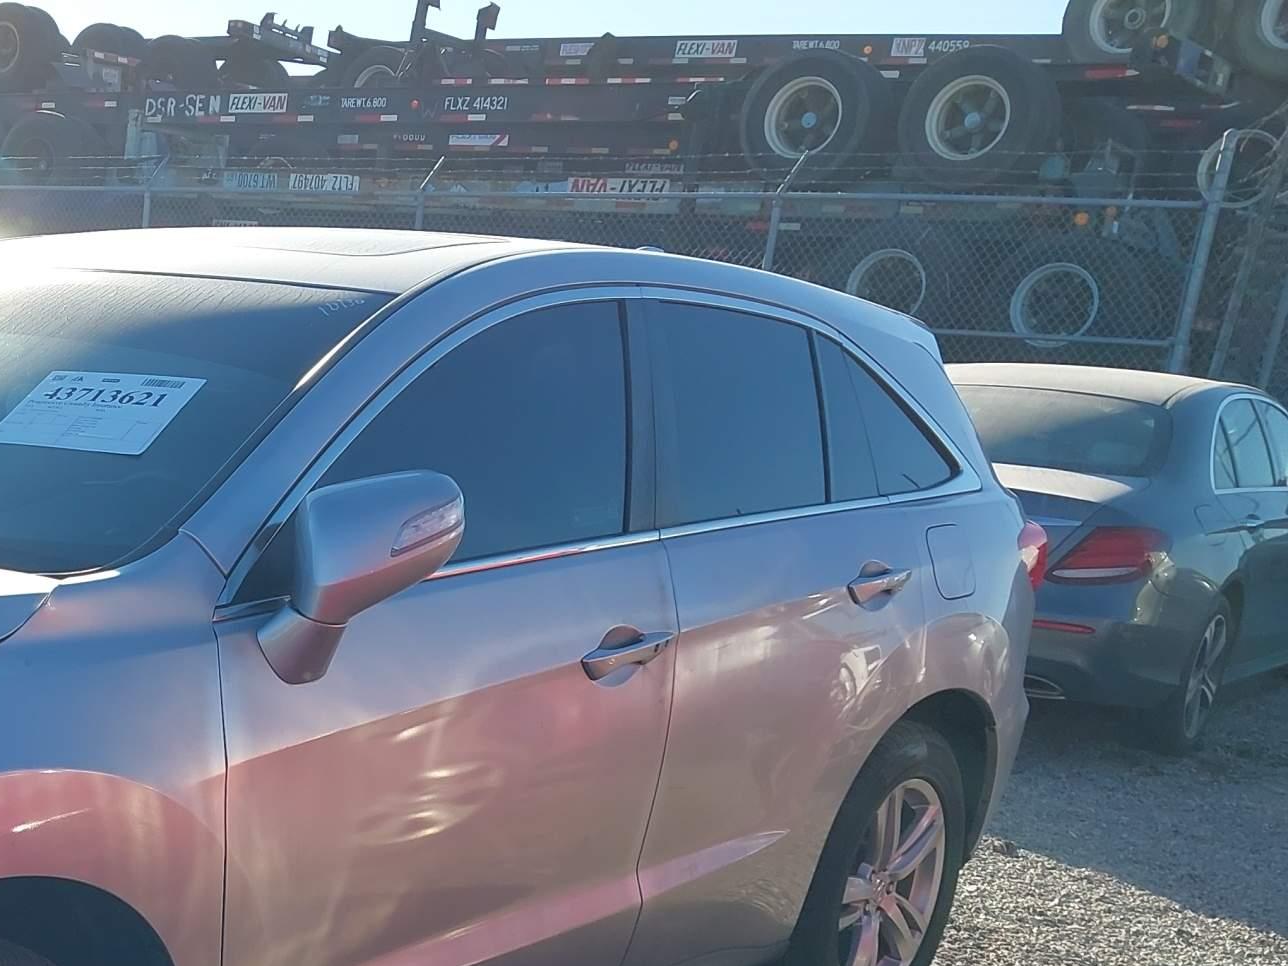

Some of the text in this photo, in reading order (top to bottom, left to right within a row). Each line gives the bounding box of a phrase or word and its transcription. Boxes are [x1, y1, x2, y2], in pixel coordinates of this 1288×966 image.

[676, 40, 736, 57] FLEXI-VAN
[230, 94, 287, 112] FLEXI-VAN
[444, 96, 508, 110] FLXZ 414321
[43, 387, 168, 407] 43713621
